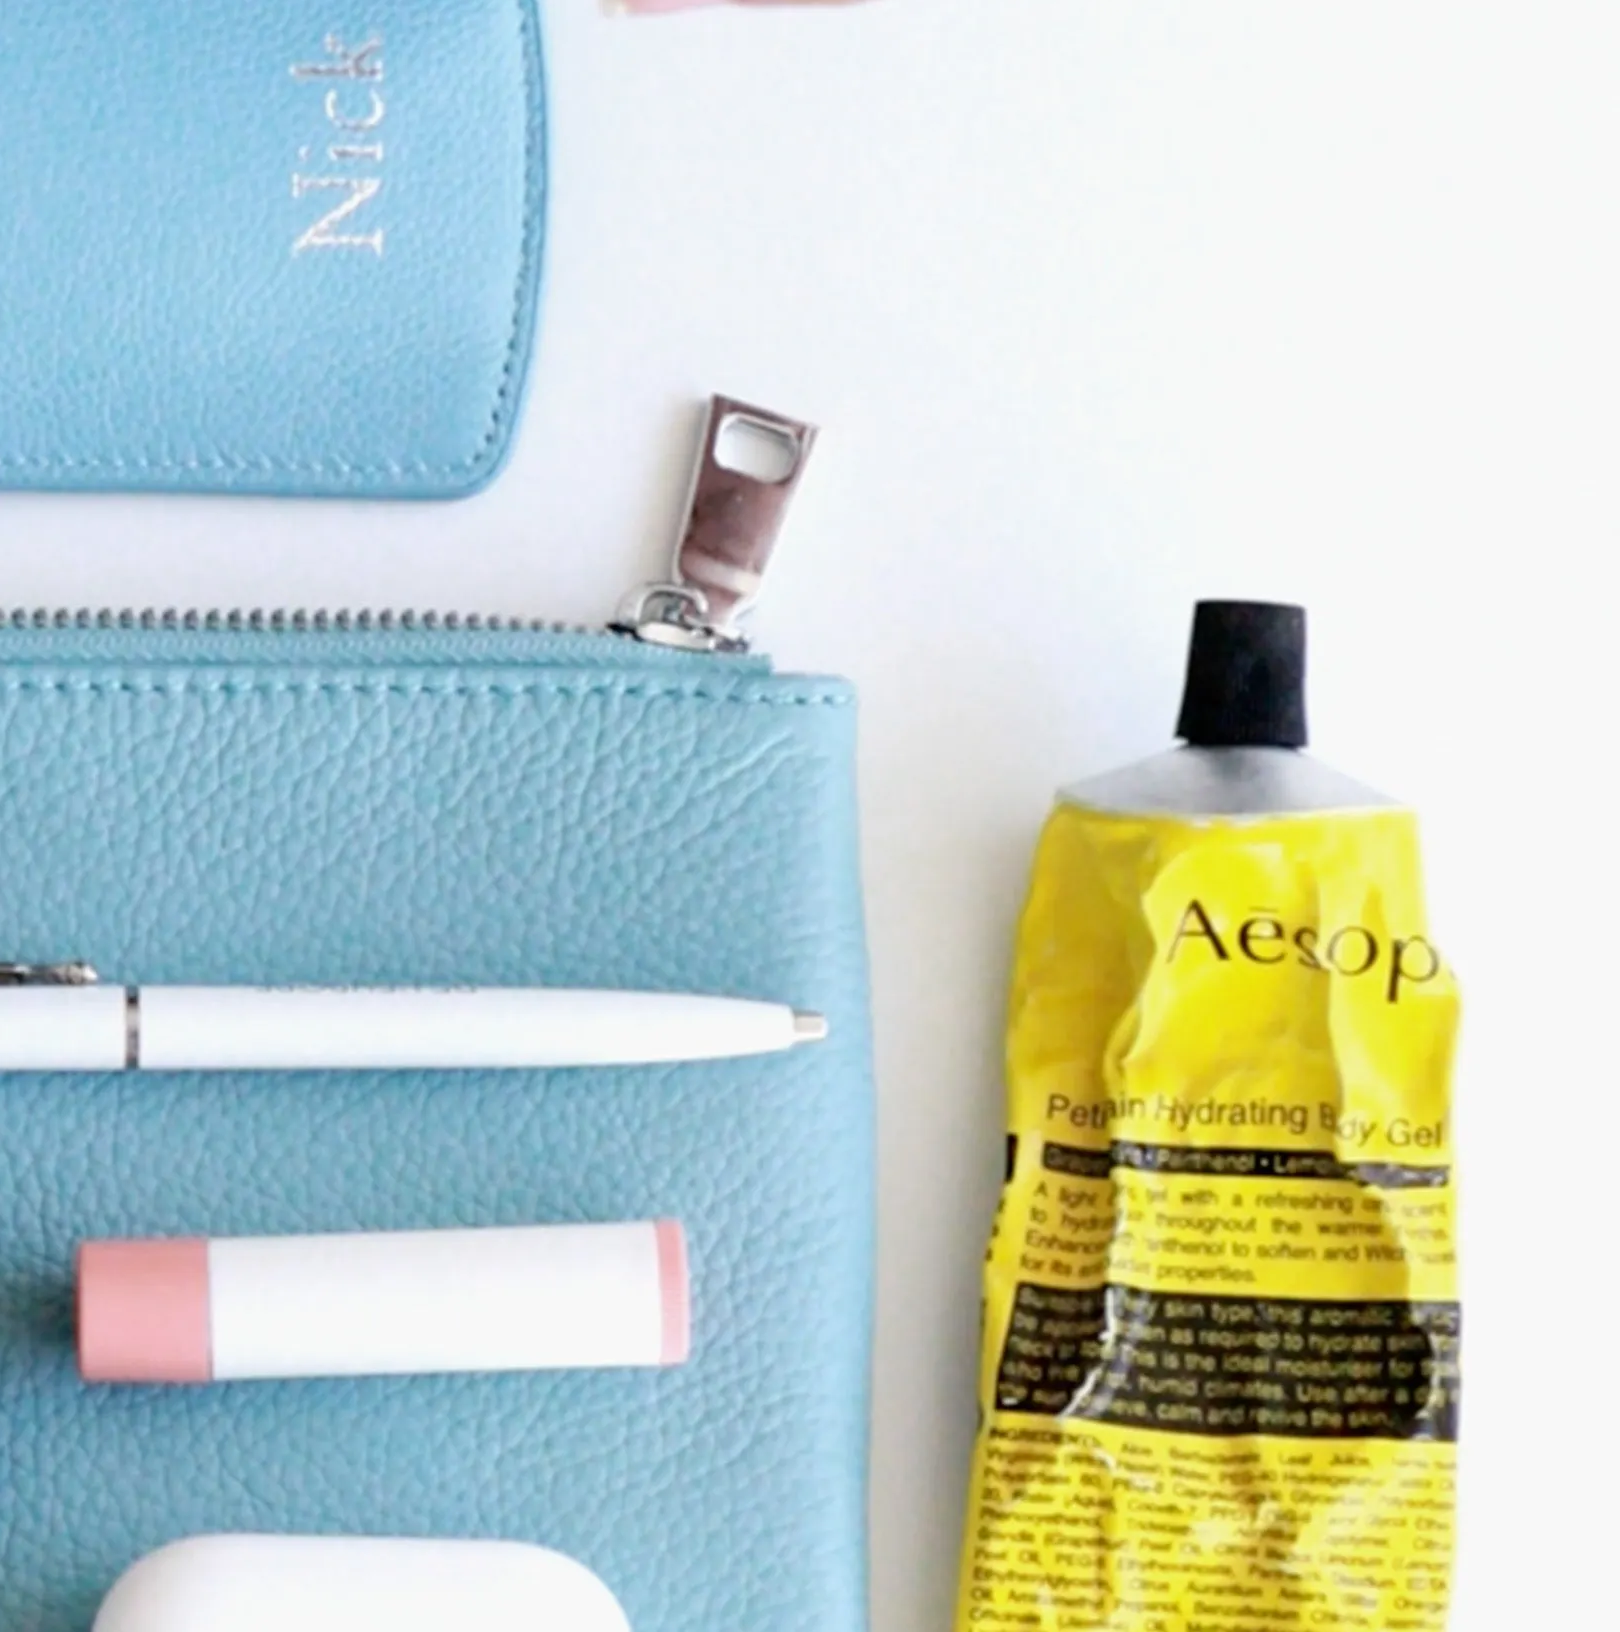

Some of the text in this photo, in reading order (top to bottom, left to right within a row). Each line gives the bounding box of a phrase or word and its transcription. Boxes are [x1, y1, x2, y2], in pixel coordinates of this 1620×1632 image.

[288, 30, 384, 257] Nick
[1155, 1093, 1307, 1135] Hydrating
[1385, 1117, 1443, 1149] Gel
[1034, 1182, 1048, 1197] A
